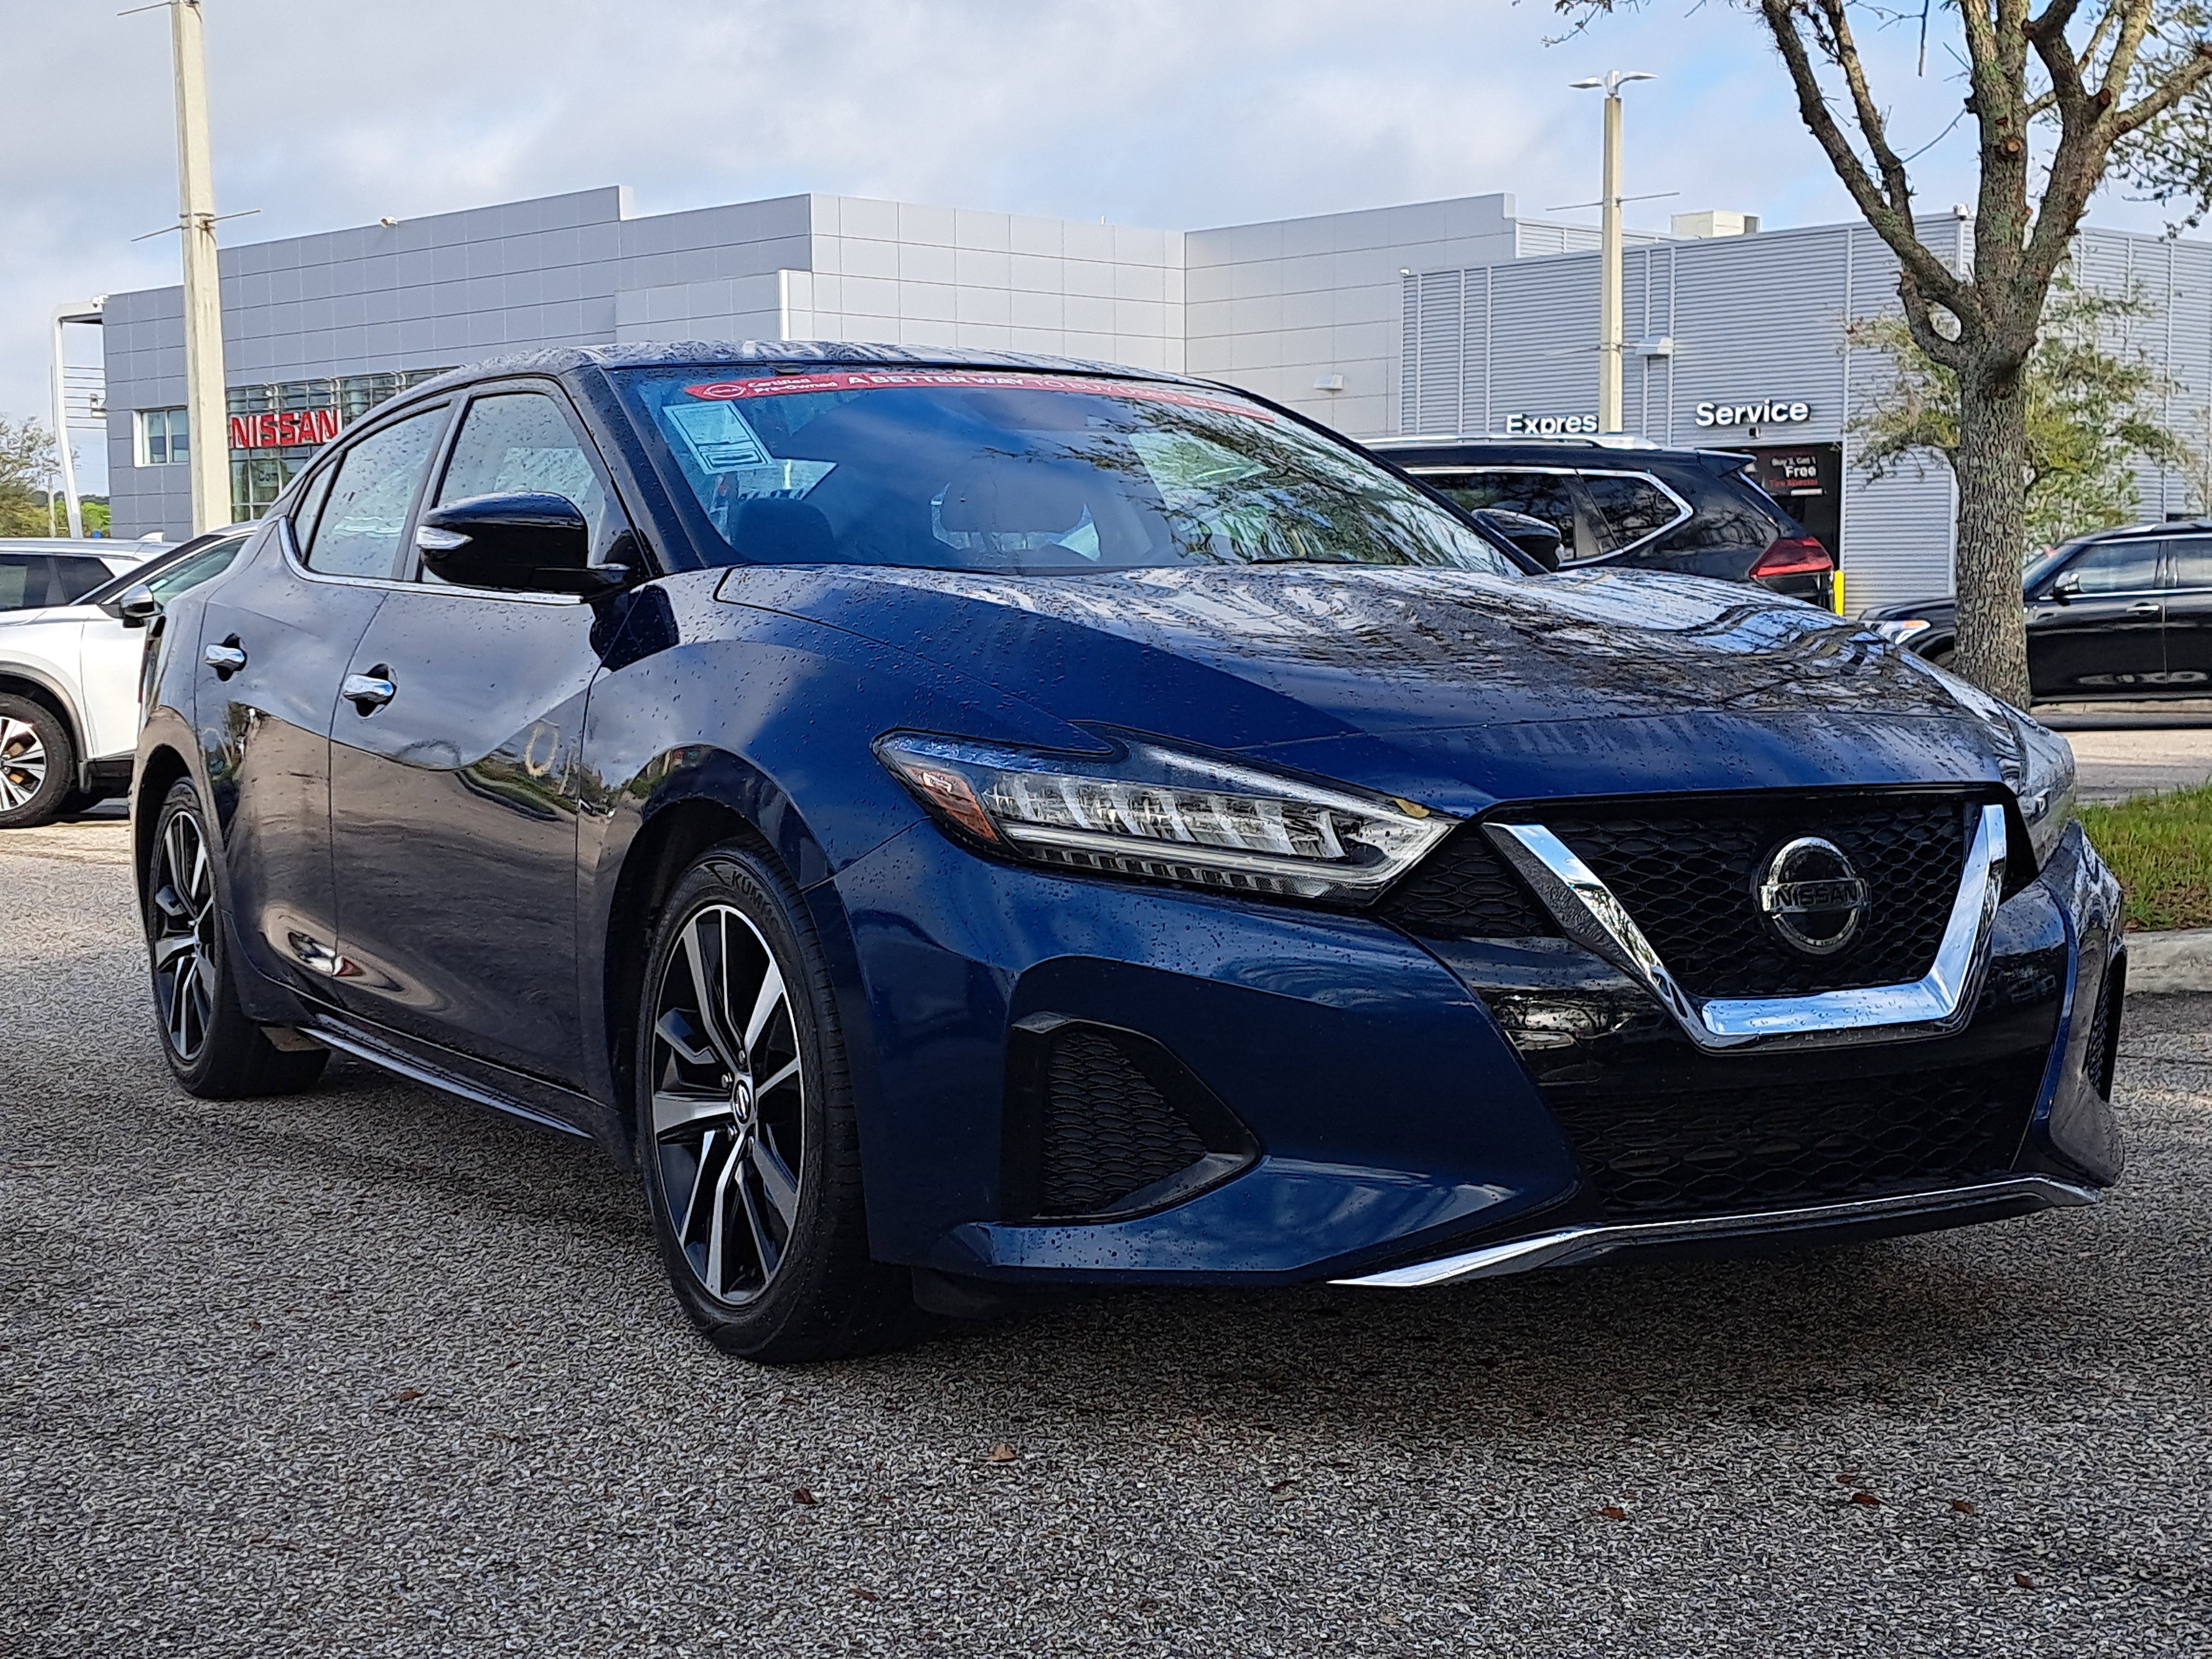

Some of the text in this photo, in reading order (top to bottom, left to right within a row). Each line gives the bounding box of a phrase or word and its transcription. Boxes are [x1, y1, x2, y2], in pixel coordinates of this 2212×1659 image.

[848, 376, 869, 384] A
[869, 376, 970, 384] BETTER
[970, 376, 1025, 385] WAY
[1695, 398, 1809, 426] Service
[231, 409, 342, 448] NISSAN
[1507, 414, 1598, 434] Expres
[1785, 465, 1816, 478] Free
[1773, 883, 1858, 907] NISSAN
